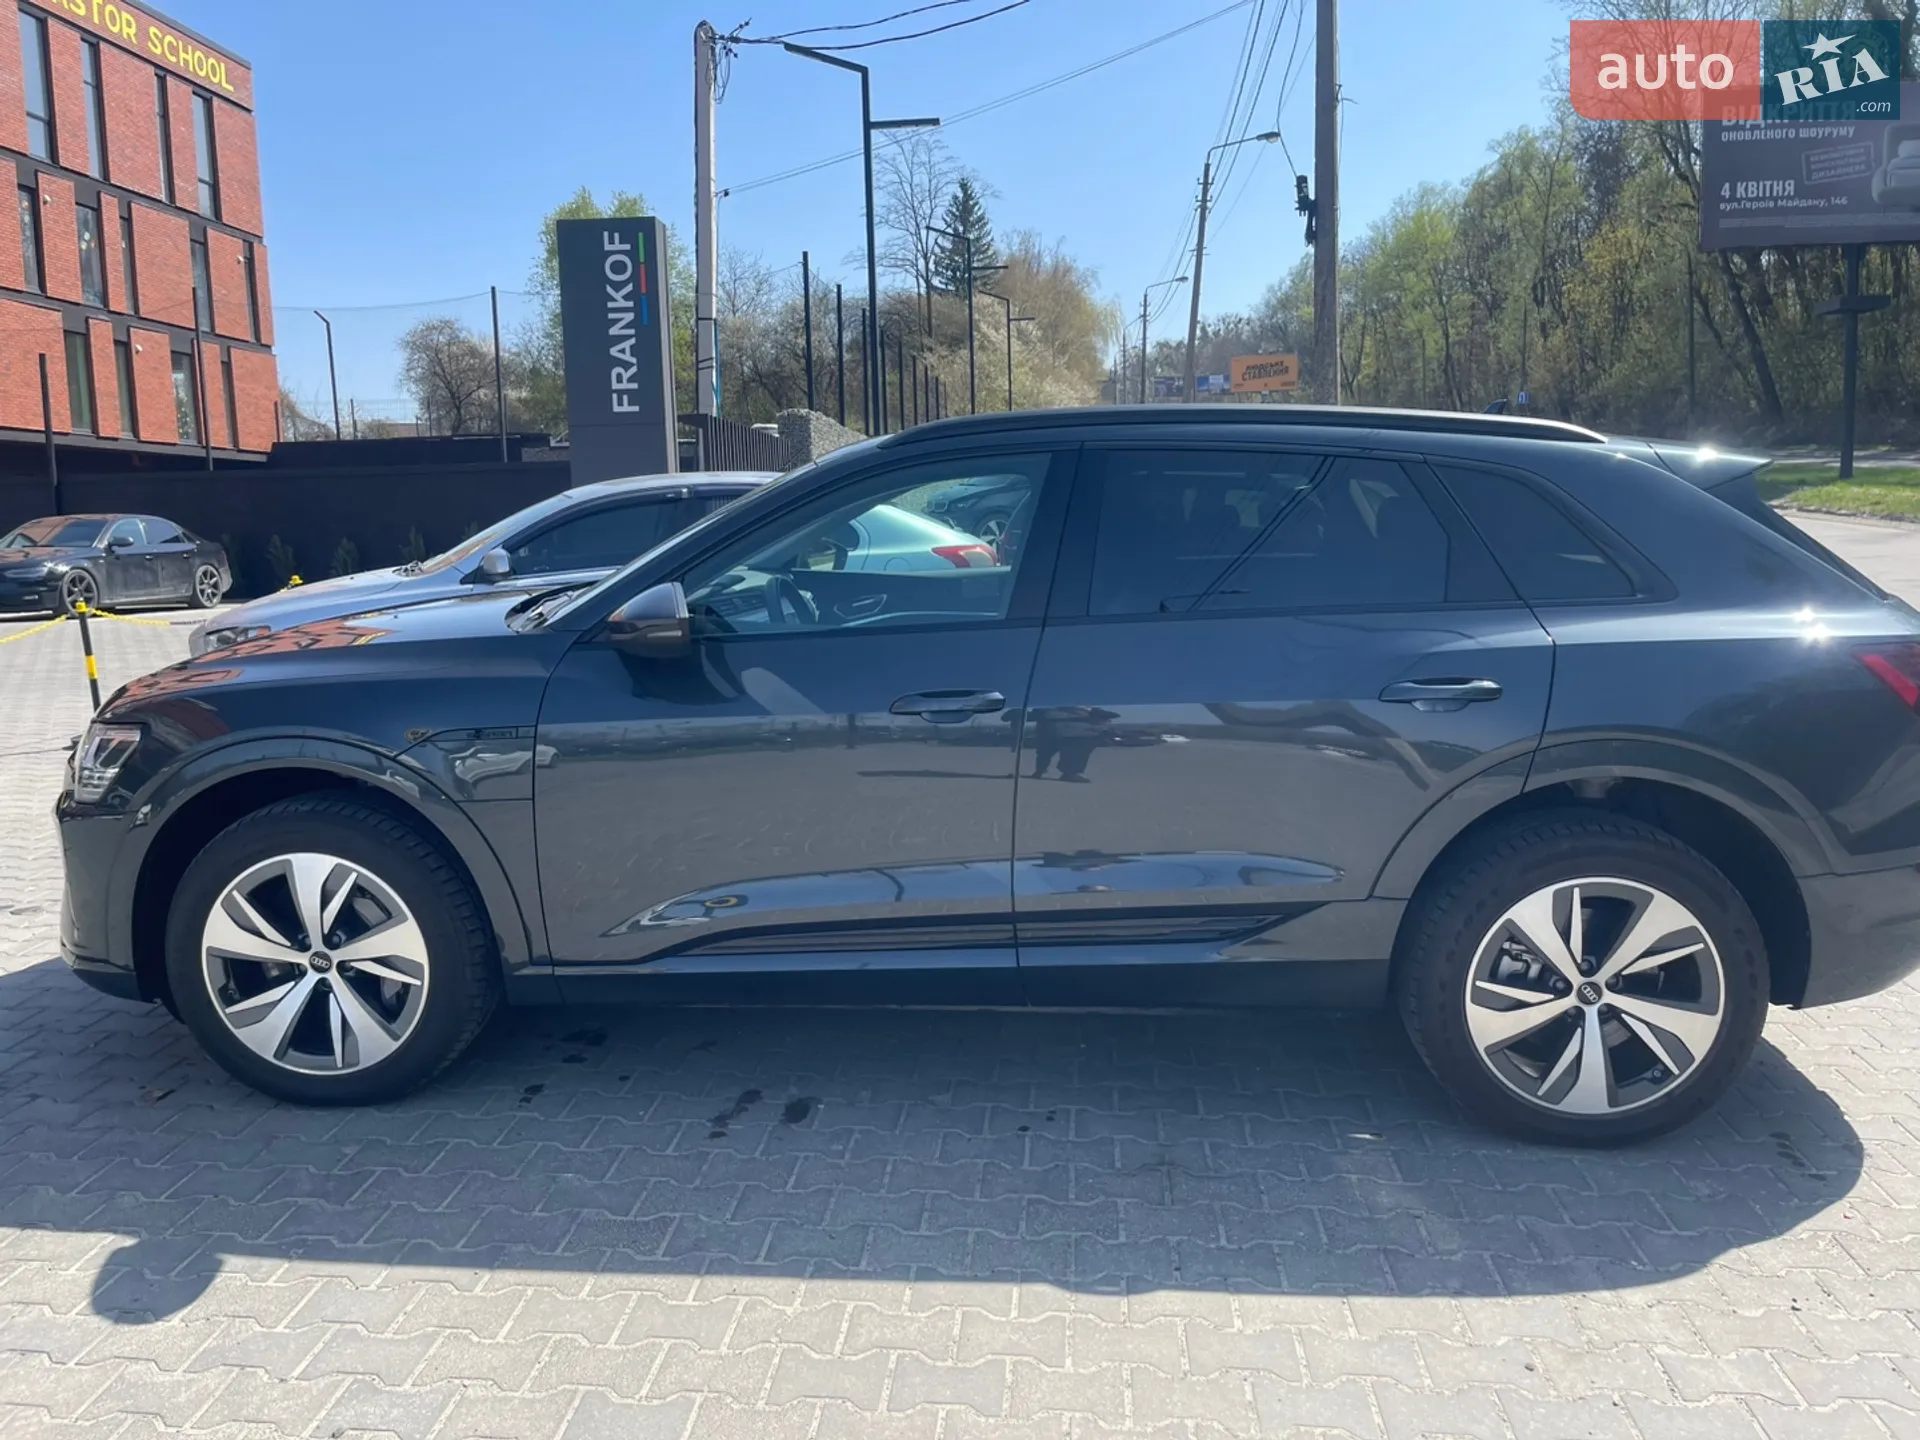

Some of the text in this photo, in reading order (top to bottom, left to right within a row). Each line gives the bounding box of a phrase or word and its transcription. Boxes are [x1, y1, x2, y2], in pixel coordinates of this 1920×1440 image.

[148, 26, 234, 92] SCHOOL
[1721, 126, 1855, 142] ОНОВЛЕНОГО ШОУРУМУ
[1721, 180, 1795, 199] 4 КВІТНЯ
[603, 231, 640, 413] FRANKOF
